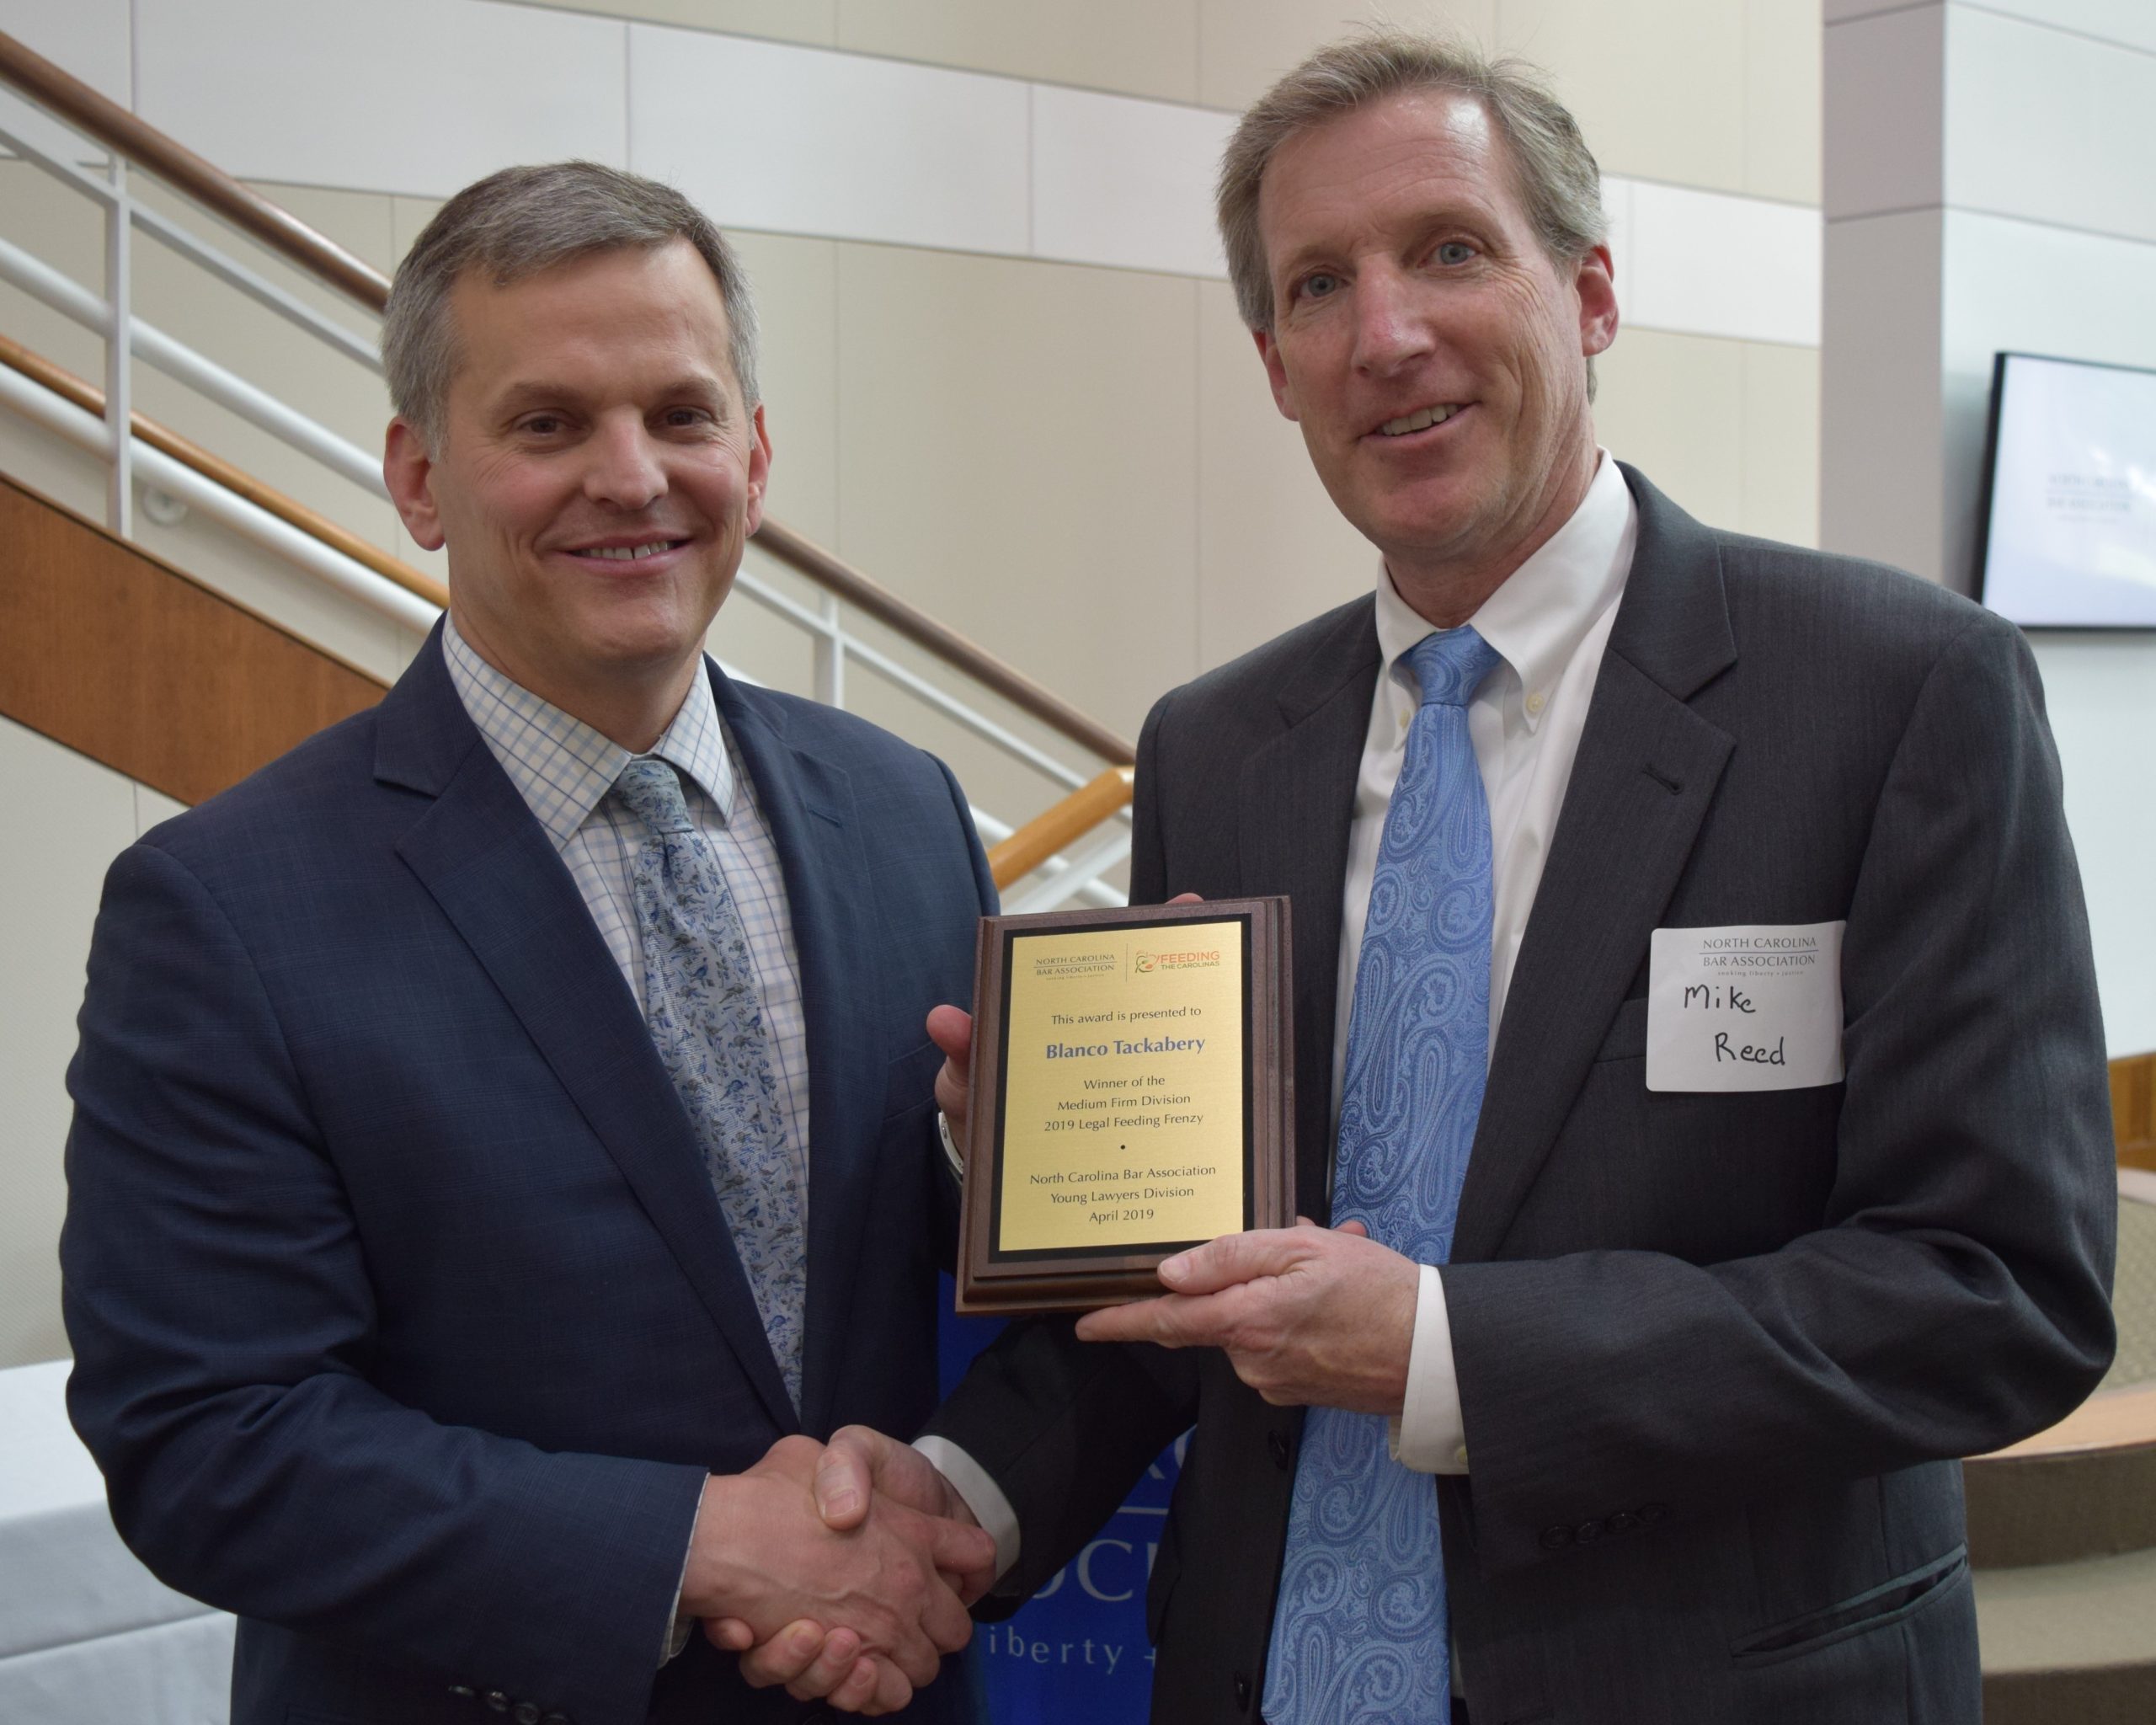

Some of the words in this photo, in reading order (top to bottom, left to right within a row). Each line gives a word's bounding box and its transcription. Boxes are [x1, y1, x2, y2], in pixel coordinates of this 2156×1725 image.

[1703, 937, 1749, 949] NORTH
[1753, 937, 1817, 948] CAROLINA
[1036, 957, 1067, 965] NORTH
[1070, 953, 1115, 963] CAROLINA
[1161, 950, 1220, 964] FEEDING
[1177, 961, 1220, 969] CAROLINAS
[1703, 957, 1726, 966] BAR
[1730, 955, 1815, 967] ASSOCIATION
[1037, 968, 1053, 976] BAR
[1054, 964, 1115, 975] ASSOCIATION
[1684, 984, 1757, 1013] Mike
[1051, 1014, 1074, 1025] This
[1077, 1011, 1113, 1023] award
[1118, 1010, 1126, 1021] is
[1129, 1006, 1186, 1023] presented
[1190, 1007, 1202, 1017] to
[1046, 1043, 1108, 1059] Blanco
[1113, 1036, 1205, 1055] Tackabery
[1715, 1032, 1785, 1065] Reed
[1084, 1078, 1128, 1090] Winner
[1131, 1076, 1144, 1087] of
[1146, 1075, 1166, 1086] the
[1057, 1097, 1107, 1111] Medium
[1111, 1097, 1137, 1108] Firm
[1141, 1094, 1191, 1106] Division
[1044, 1119, 1075, 1131] 2019
[1079, 1117, 1110, 1131] Legal
[1113, 1114, 1161, 1129] Feeding
[1164, 1114, 1203, 1125] Frenzy
[1030, 1172, 1064, 1185] North
[1068, 1168, 1119, 1183] Carolina
[1123, 1168, 1144, 1179] Bar
[1146, 1165, 1216, 1178] Association
[1050, 1192, 1087, 1205] Young
[1091, 1188, 1139, 1203] Lawyers
[1144, 1186, 1194, 1199] Division
[1089, 1210, 1118, 1225] April
[1123, 1209, 1154, 1220] 2019
[989, 1626, 1123, 1675] iberty
